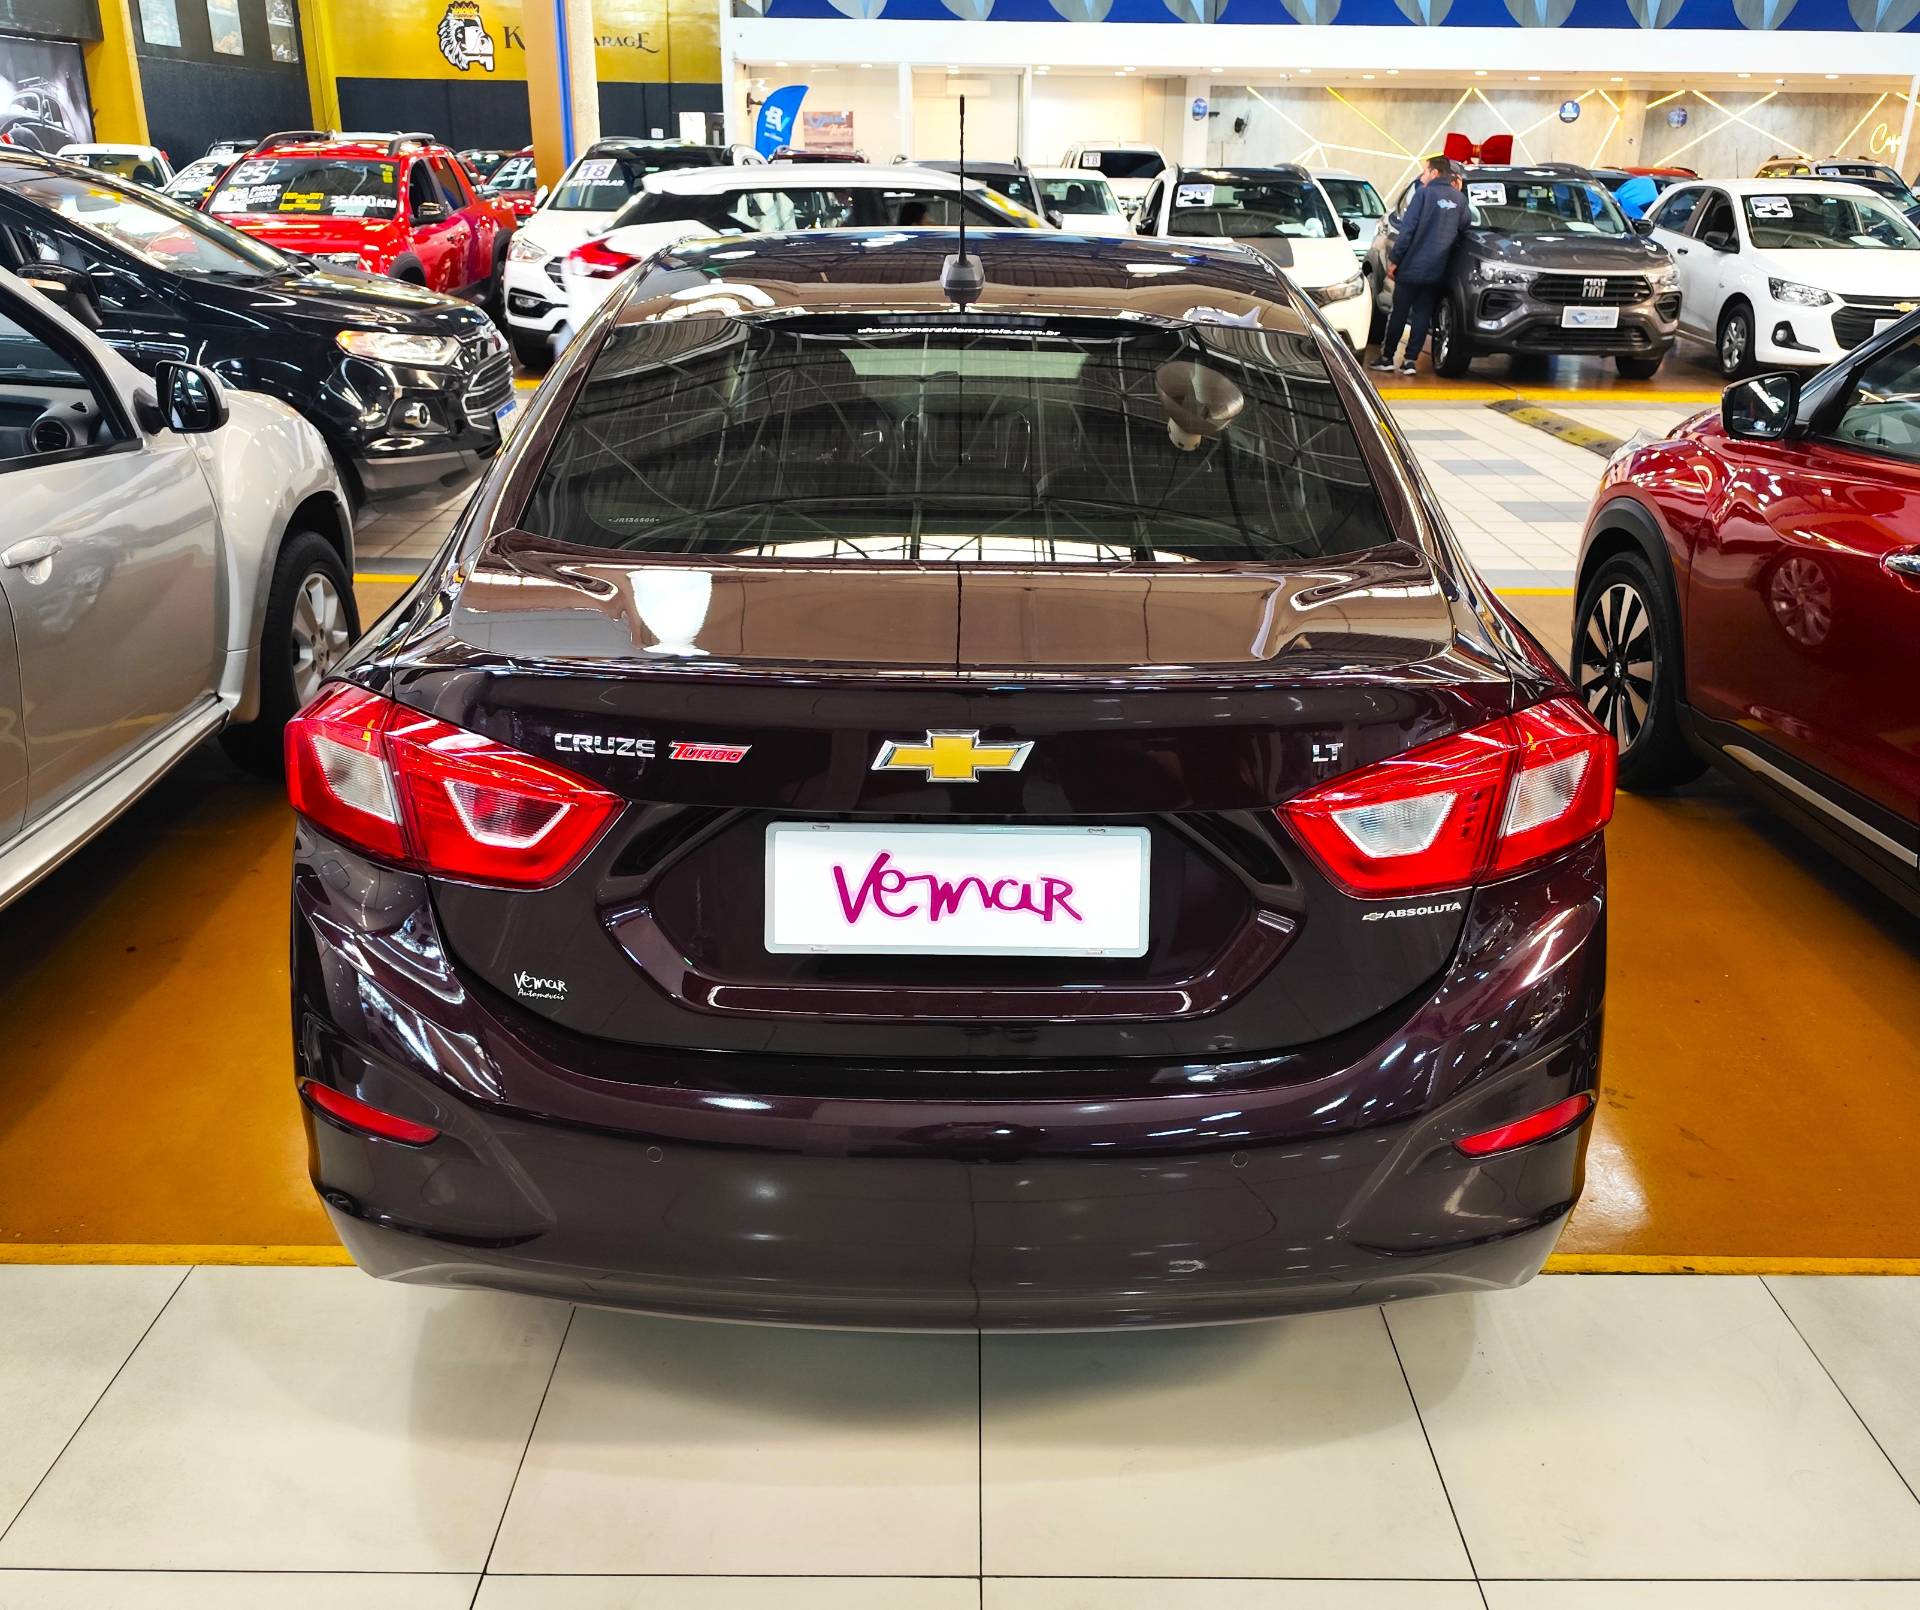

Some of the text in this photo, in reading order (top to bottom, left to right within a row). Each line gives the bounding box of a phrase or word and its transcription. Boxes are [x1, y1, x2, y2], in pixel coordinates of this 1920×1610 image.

[231, 165, 268, 183] 25
[581, 163, 608, 177] 18
[1470, 189, 1503, 205] 24
[1754, 203, 1791, 217] 25
[1582, 278, 1608, 298] FIAT
[554, 732, 656, 758] CRUZE
[1312, 742, 1344, 763] LT
[1384, 902, 1462, 919] ABSOLUTA
